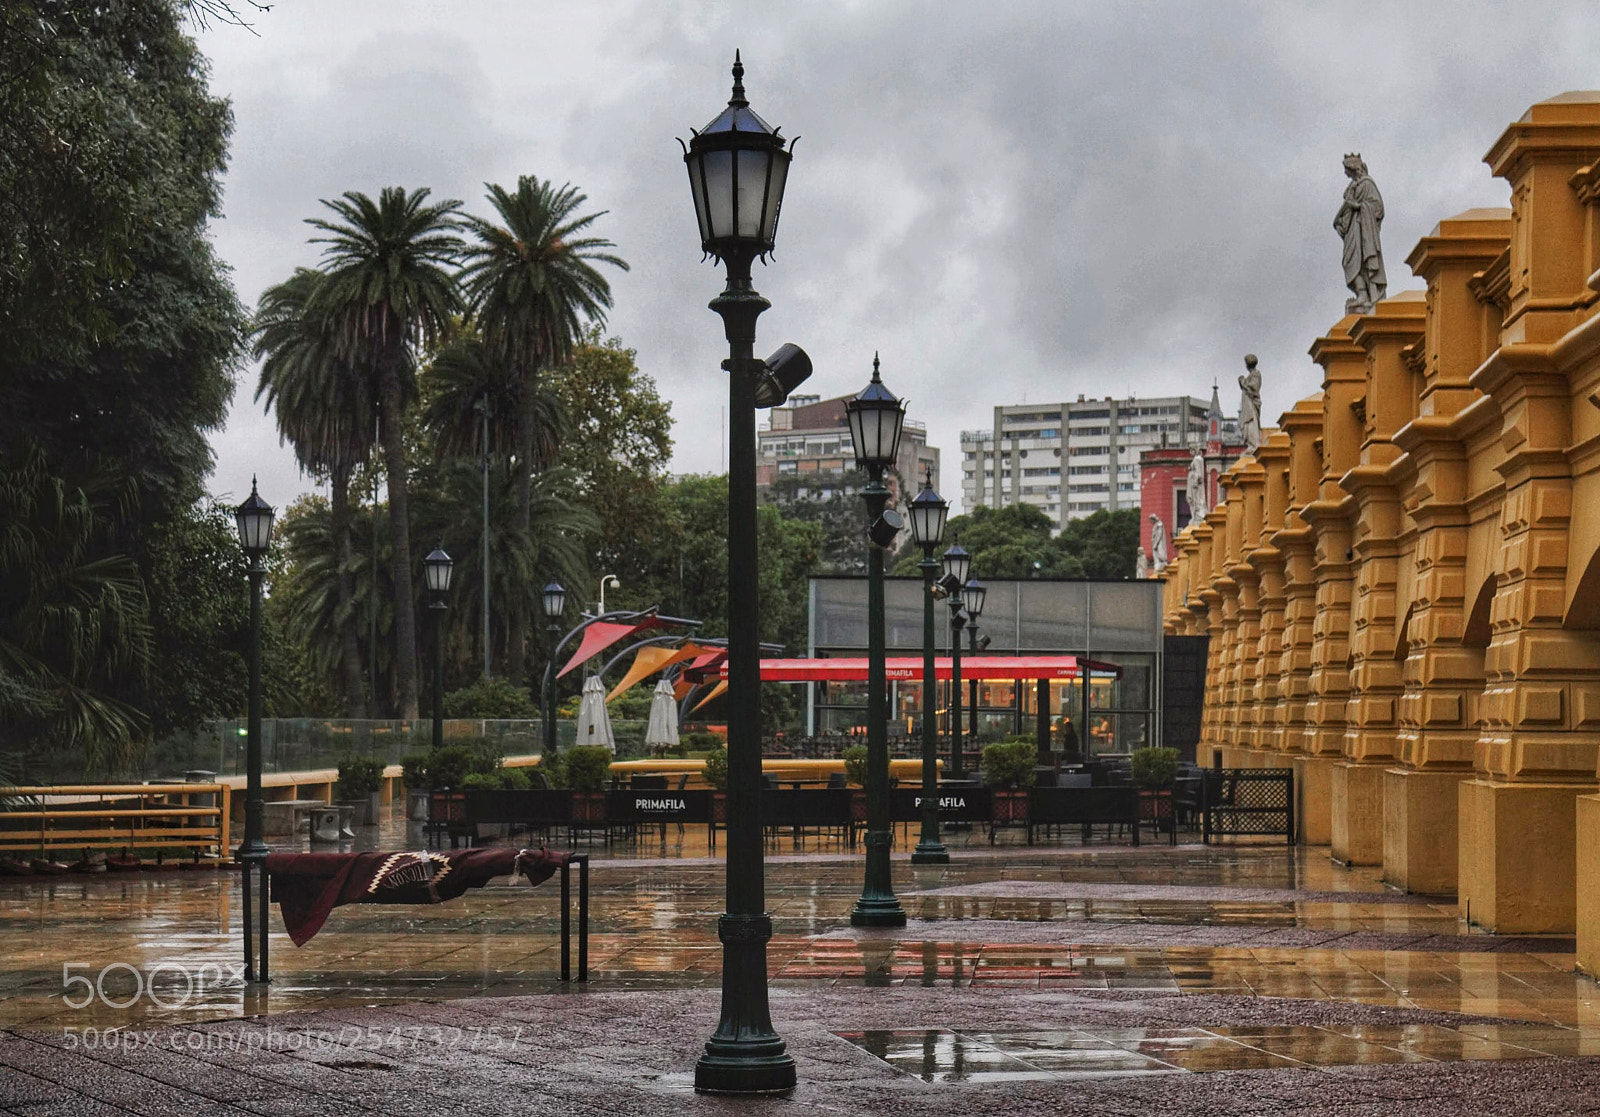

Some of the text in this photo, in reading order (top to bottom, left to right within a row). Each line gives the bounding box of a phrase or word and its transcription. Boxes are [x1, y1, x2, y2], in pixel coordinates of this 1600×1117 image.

[886, 669, 914, 677] RIMAFILA
[636, 799, 686, 809] PRIMAFILA
[915, 797, 966, 808] PAFILA
